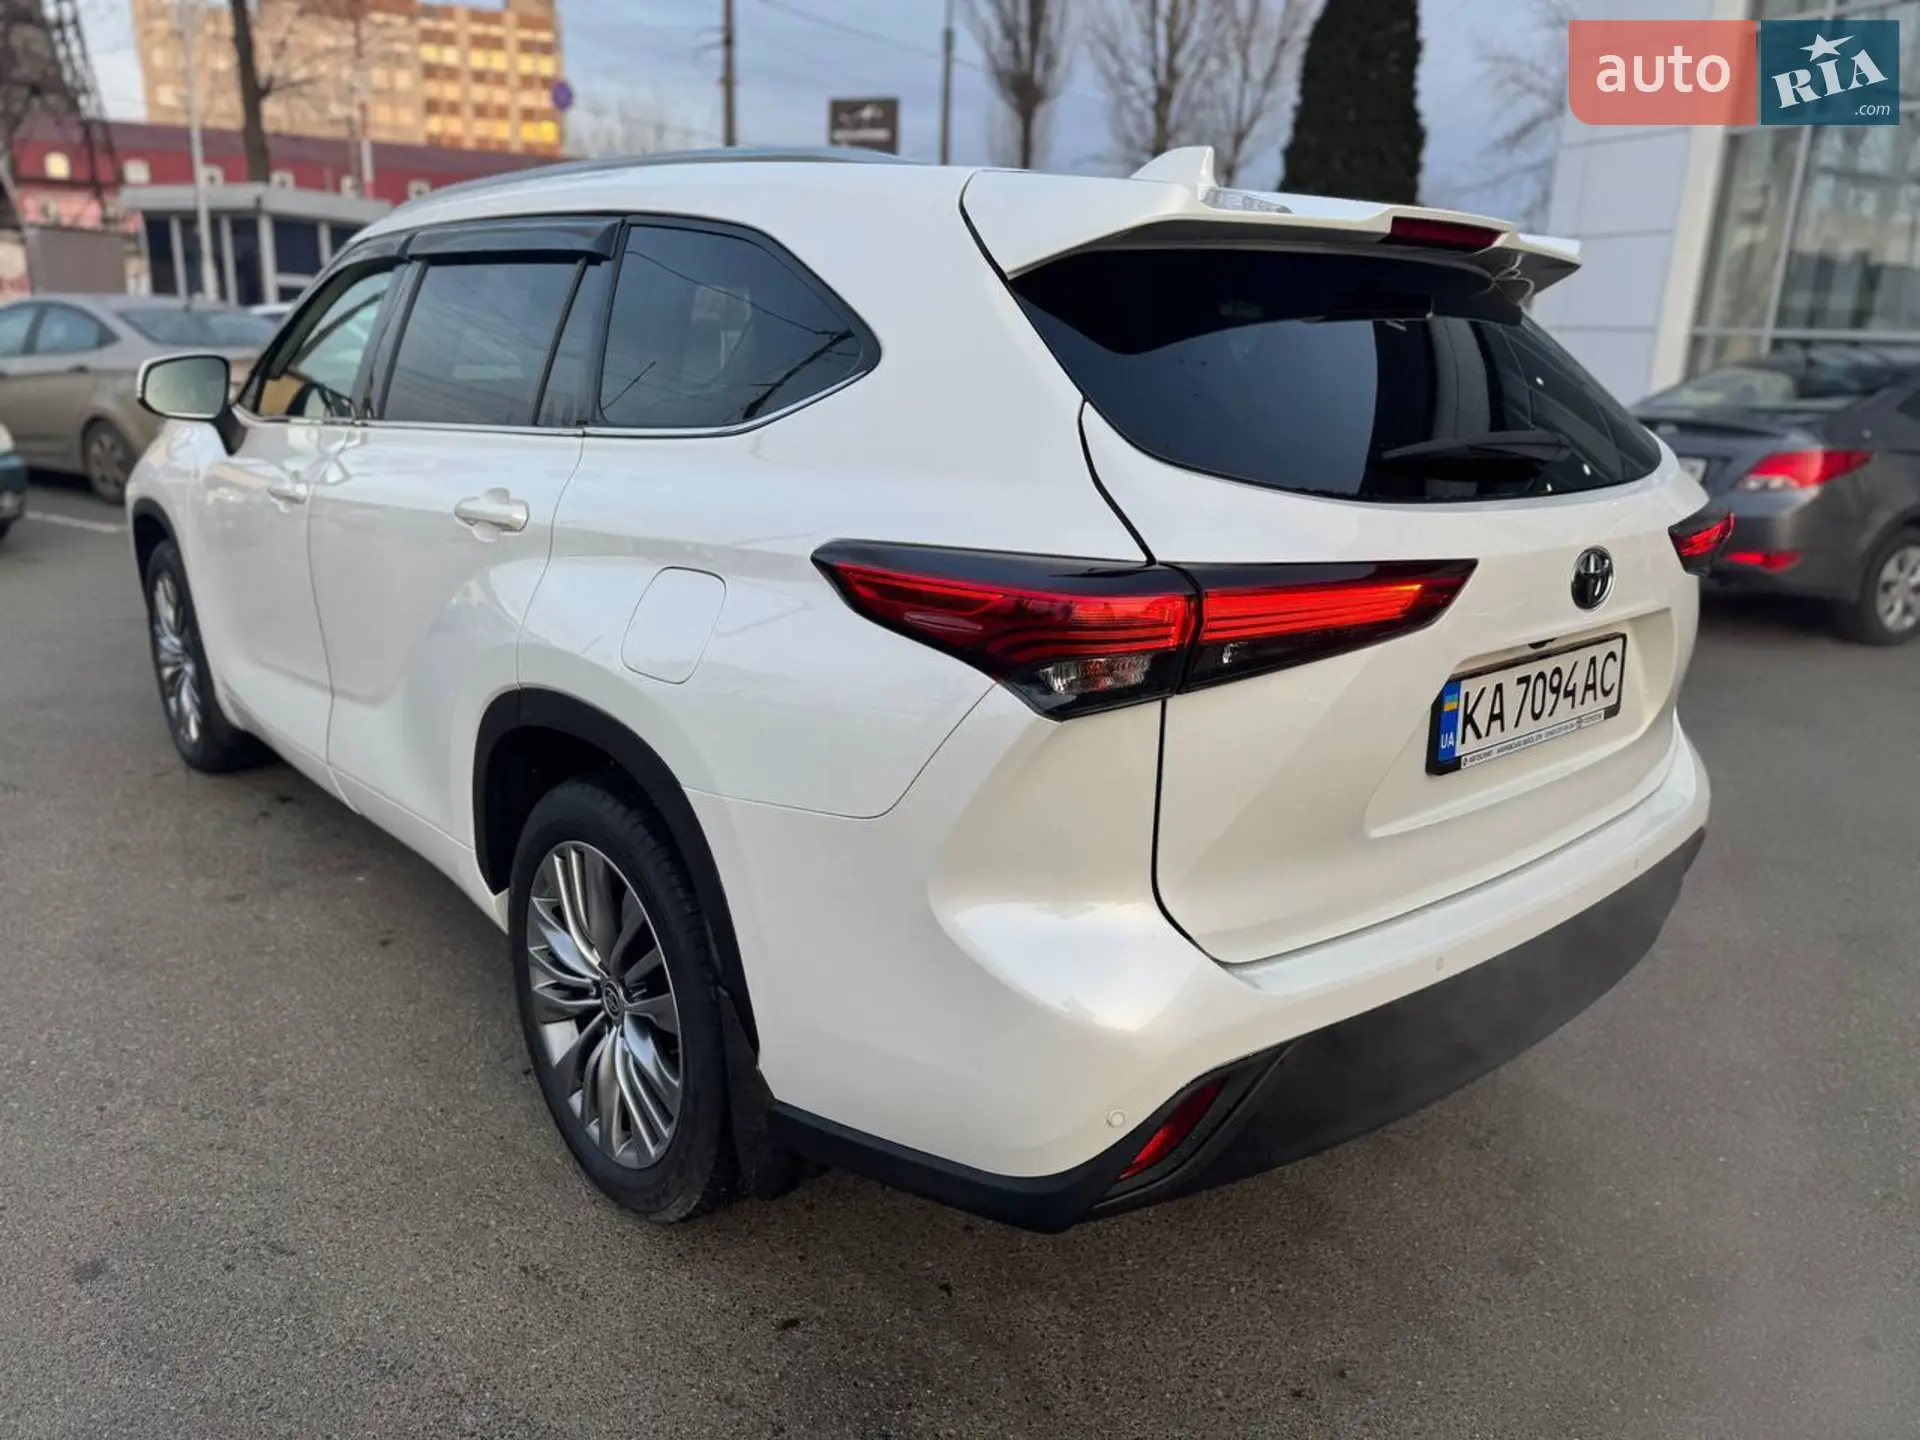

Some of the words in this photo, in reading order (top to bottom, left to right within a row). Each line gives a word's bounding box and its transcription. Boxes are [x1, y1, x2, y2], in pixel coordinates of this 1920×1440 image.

[1461, 682, 1506, 745] KA
[1514, 661, 1578, 729] 7094
[1440, 733, 1455, 748] UA
